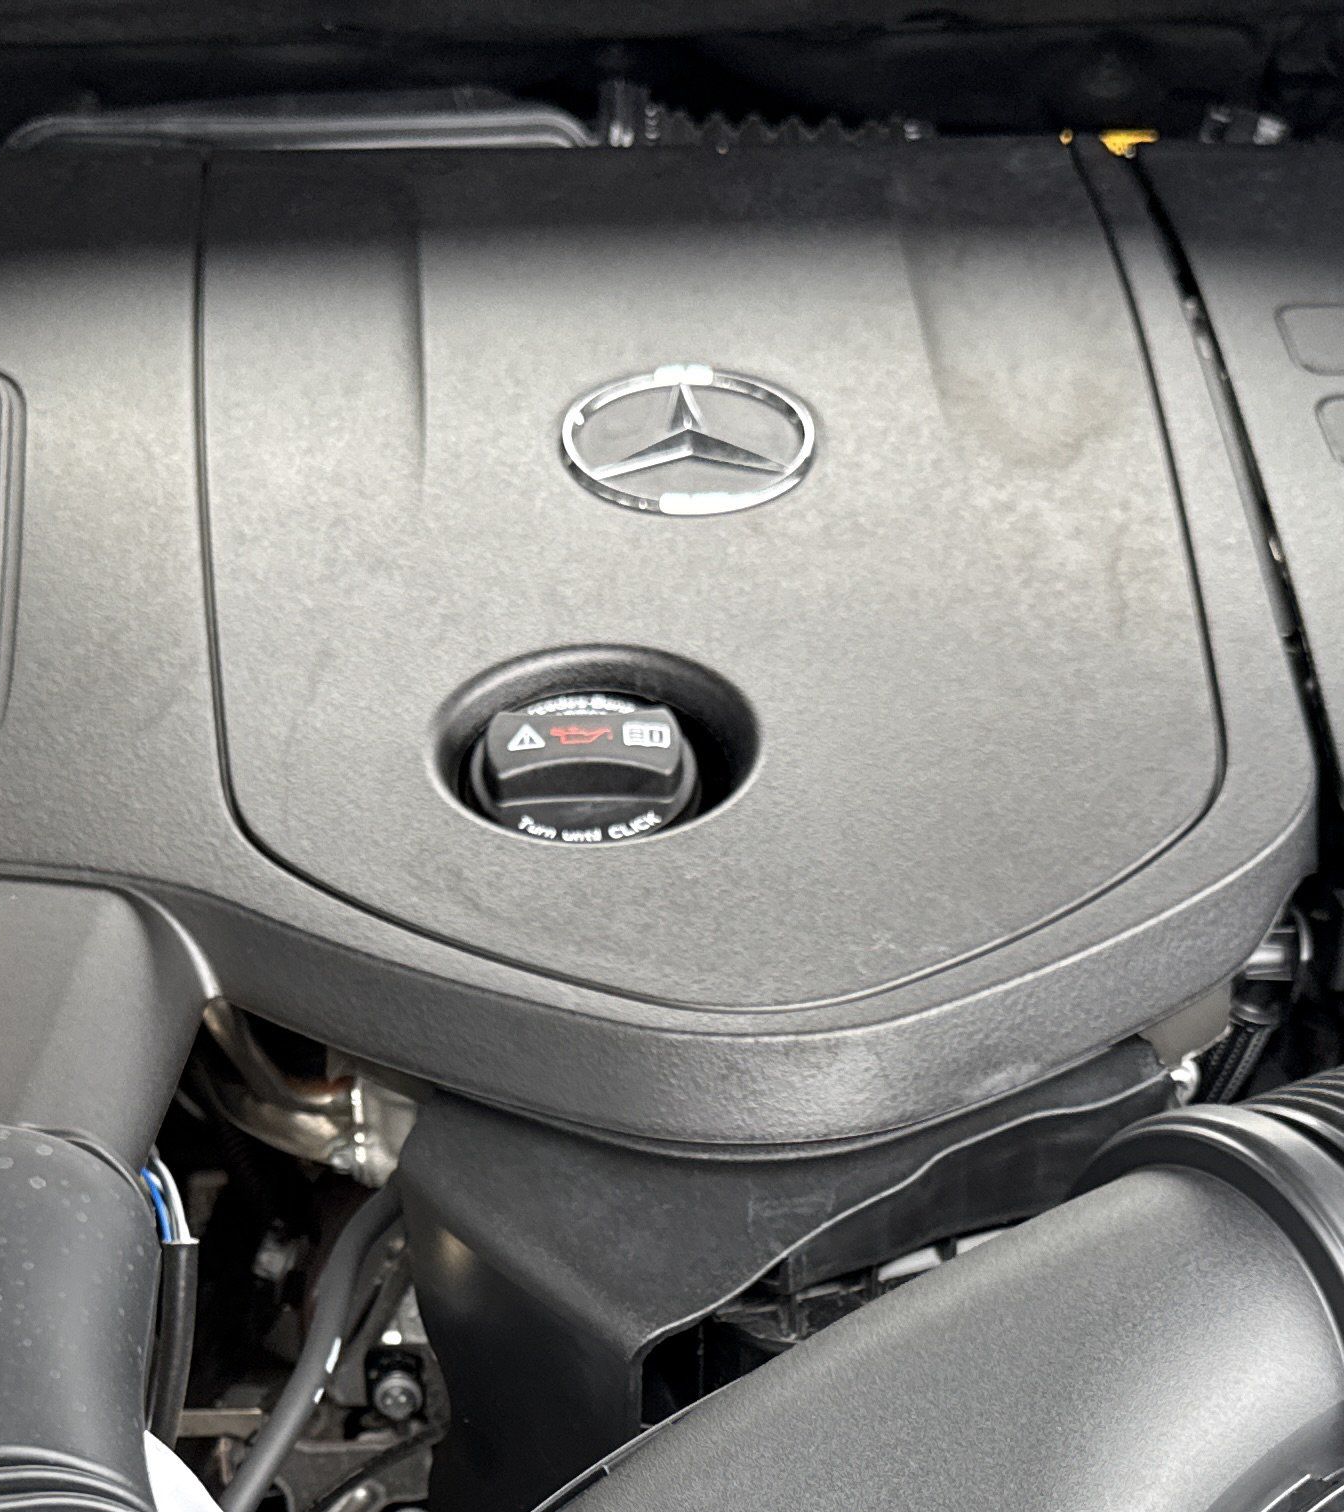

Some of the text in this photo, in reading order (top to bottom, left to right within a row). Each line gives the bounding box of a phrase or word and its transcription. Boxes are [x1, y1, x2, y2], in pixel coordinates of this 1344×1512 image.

[517, 809, 662, 842] Turn until CLICK
